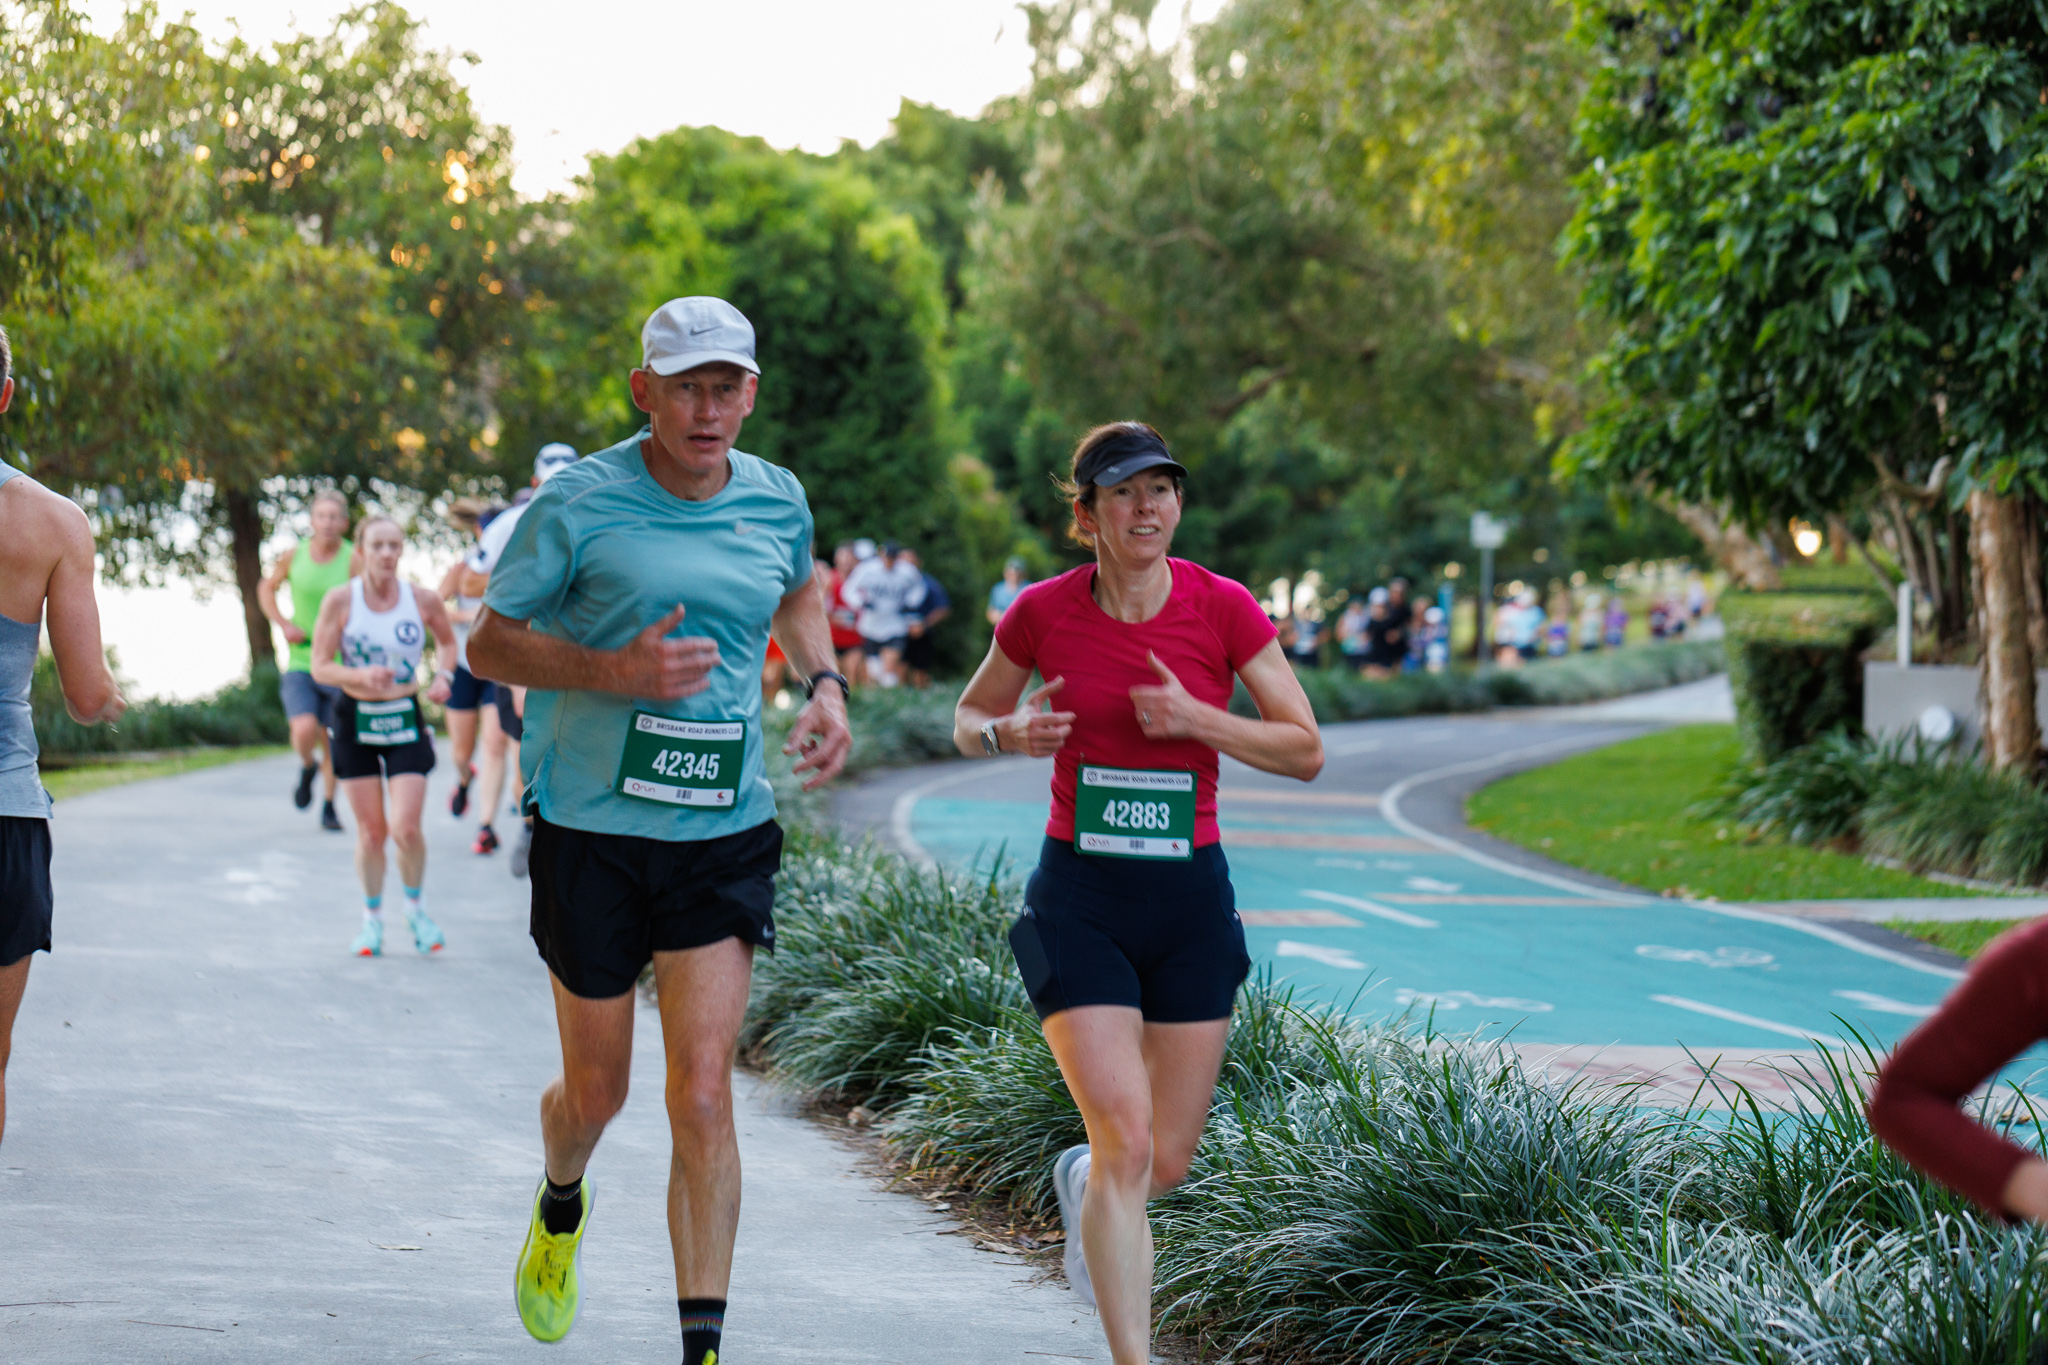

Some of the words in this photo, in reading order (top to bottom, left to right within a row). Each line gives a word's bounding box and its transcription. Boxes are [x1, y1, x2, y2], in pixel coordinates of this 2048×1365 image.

[657, 722, 686, 733] BRISBANE
[687, 726, 703, 734] ROAD
[704, 727, 728, 735] RUNNERS
[652, 749, 720, 780] 42345
[1102, 799, 1170, 830] 42883
